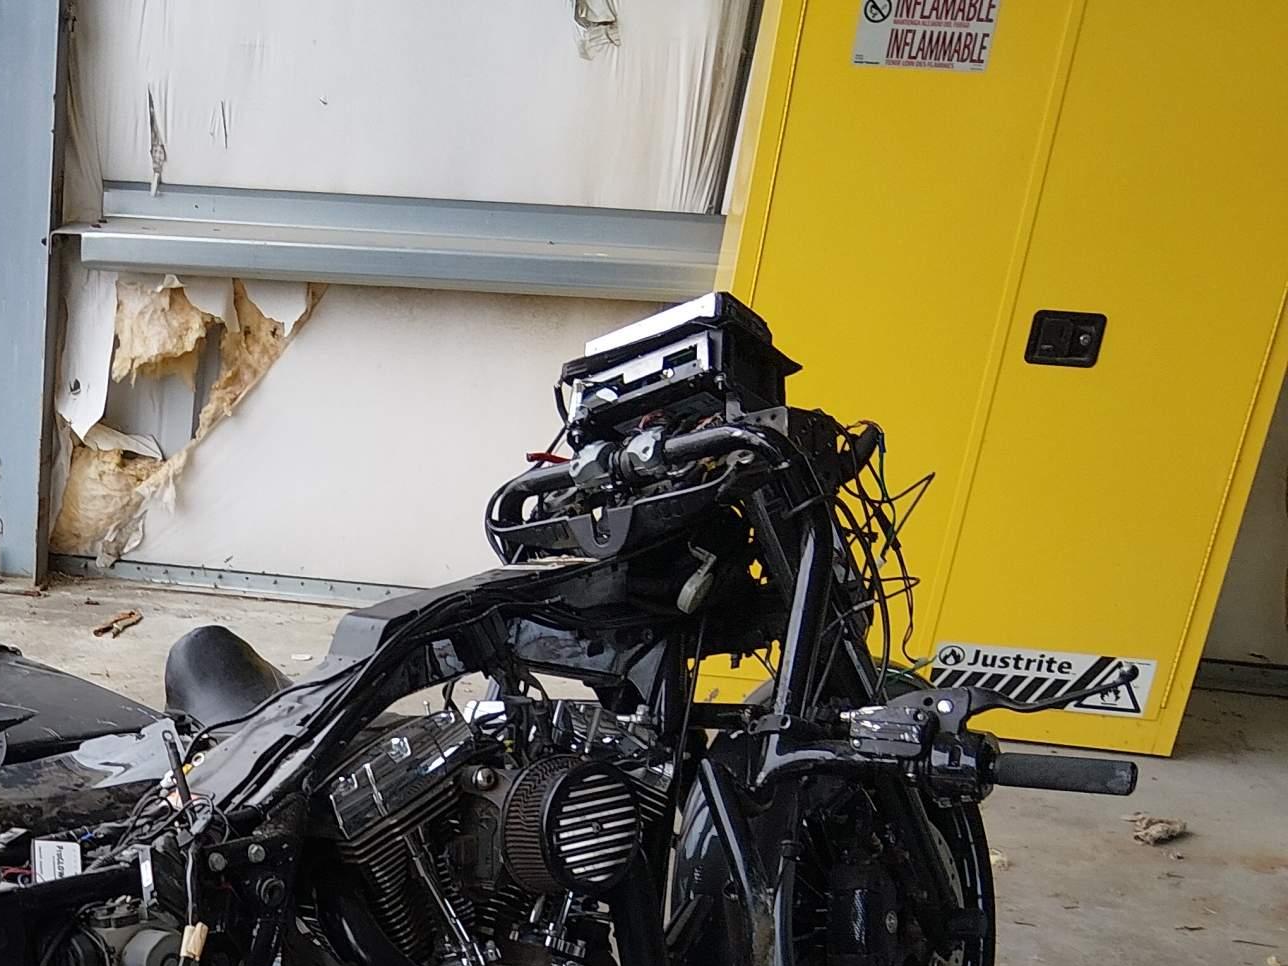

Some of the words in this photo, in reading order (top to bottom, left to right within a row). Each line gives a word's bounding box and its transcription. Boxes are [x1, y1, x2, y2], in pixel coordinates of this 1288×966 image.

[894, 0, 996, 23] INFLAMABLE
[886, 28, 990, 64] INFLAMMABLE
[967, 649, 1073, 675] Justrite
